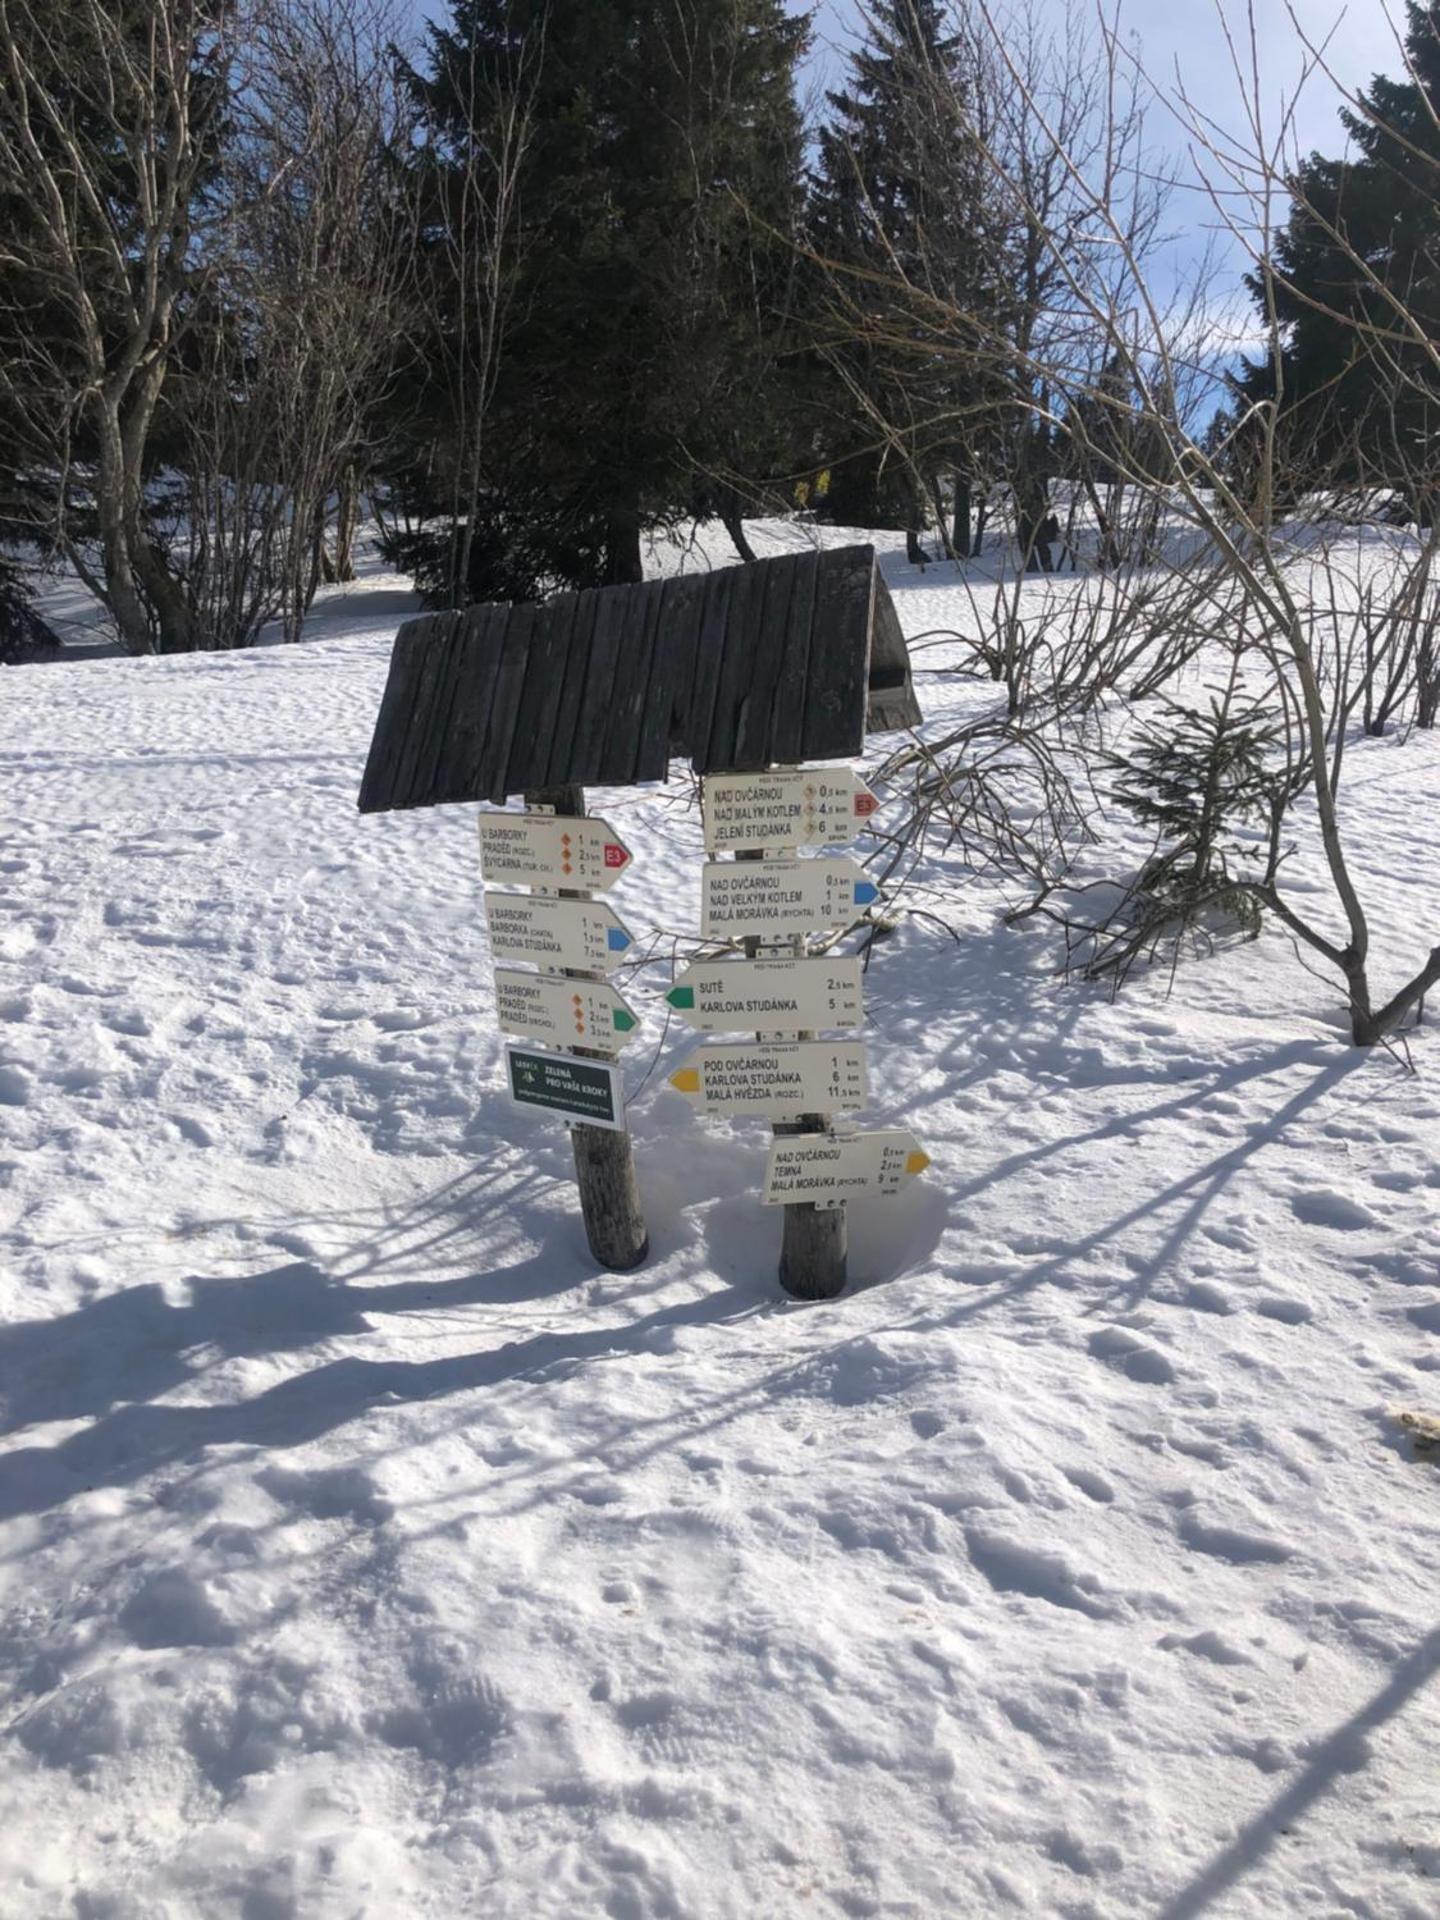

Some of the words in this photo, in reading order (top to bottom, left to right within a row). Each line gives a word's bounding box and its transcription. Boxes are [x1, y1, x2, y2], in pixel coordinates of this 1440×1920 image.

[715, 790, 732, 802] NAD
[714, 809, 732, 820] NAD
[767, 804, 800, 817] KOTLEM
[857, 799, 871, 811] E3
[819, 821, 825, 833] 6
[489, 828, 527, 840] BARBORKY
[579, 835, 583, 845] 1
[607, 851, 621, 862] E3
[580, 864, 584, 875] 5
[710, 880, 729, 891] NAD
[731, 875, 780, 889] OVČÁRNOU
[710, 895, 729, 906] NAD
[768, 891, 802, 902] KOTLEM
[826, 890, 831, 900] 1
[495, 909, 532, 920] BARBORKY
[583, 917, 587, 928] 1
[709, 908, 734, 922] MALÁ
[736, 906, 779, 920] MORÁVKA
[821, 905, 831, 915] 10
[842, 981, 855, 989] km
[701, 1001, 745, 1013] KARLOVA
[746, 998, 798, 1012] STUDÁNKA
[829, 999, 835, 1010] 5
[704, 1060, 723, 1072] POD
[726, 1057, 778, 1071] OVČÁRNOU
[832, 1057, 837, 1067] 1
[705, 1075, 748, 1086] KARLOVA
[833, 1071, 839, 1082] 6
[582, 1085, 607, 1096] KROKY
[706, 1086, 732, 1100] MALÁ
[776, 1153, 793, 1163] NAD
[770, 1179, 794, 1191] MALÁ
[796, 1177, 835, 1189] MORÁVKA
